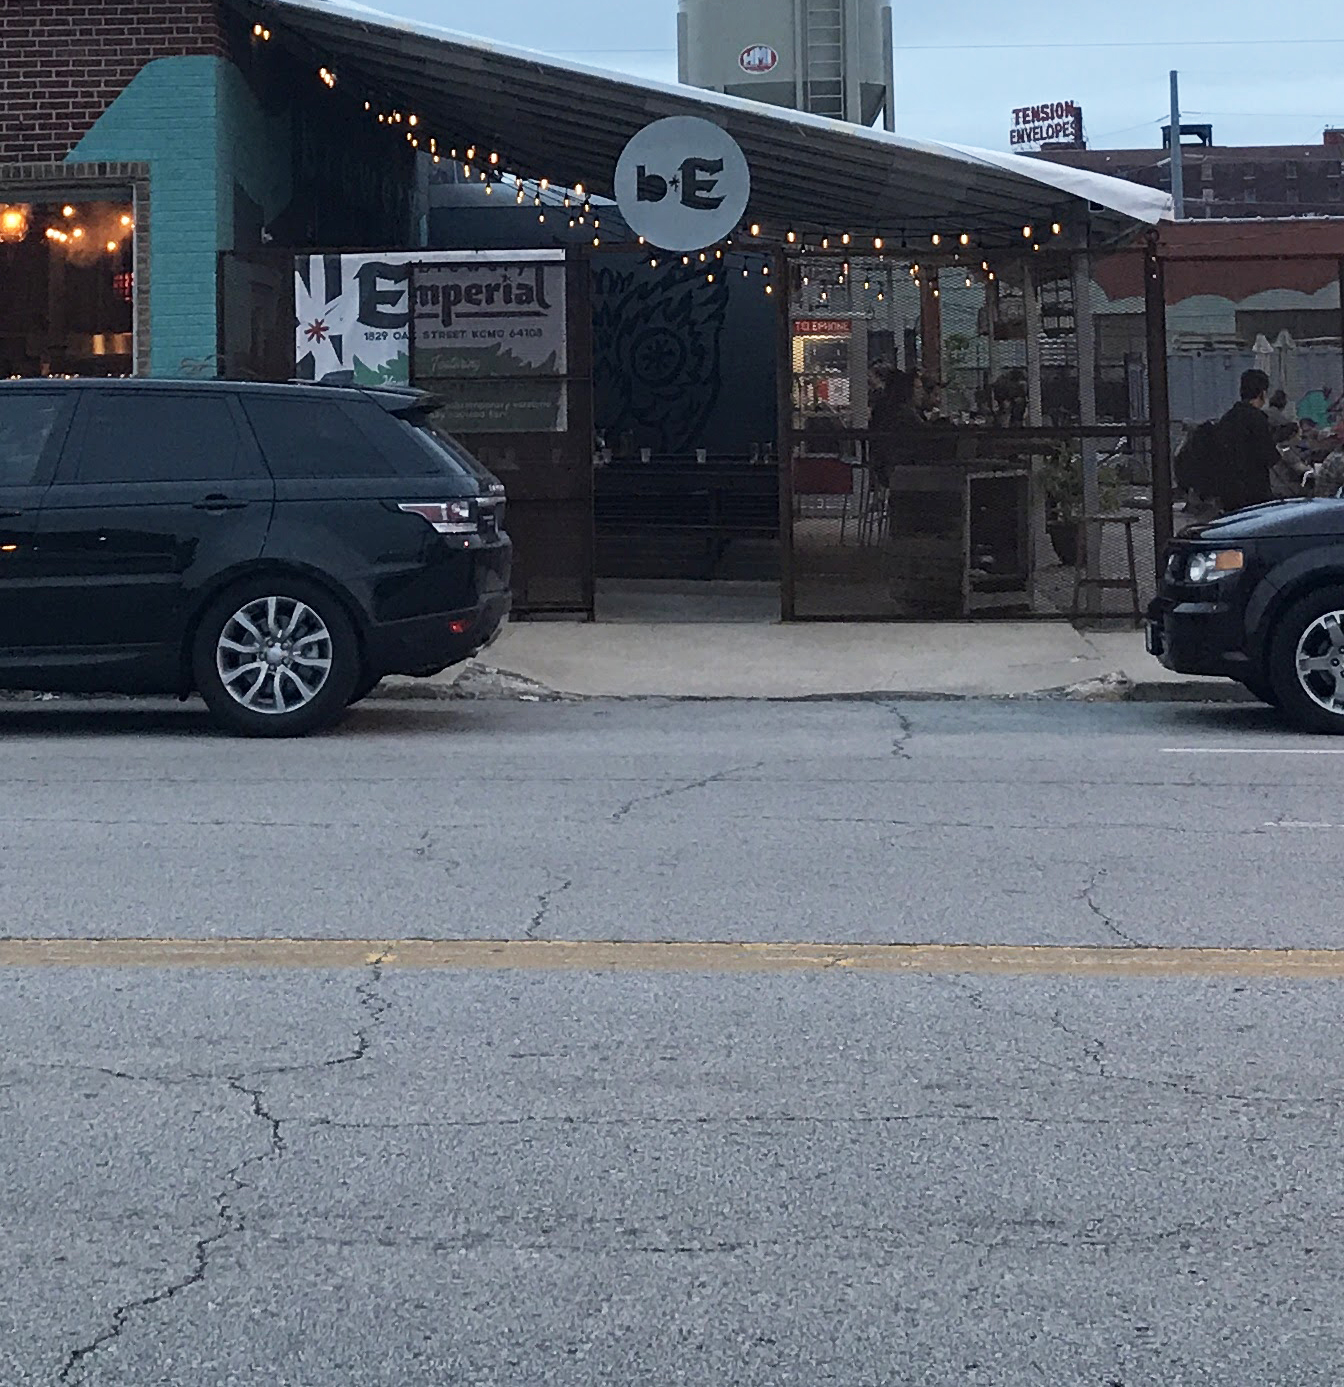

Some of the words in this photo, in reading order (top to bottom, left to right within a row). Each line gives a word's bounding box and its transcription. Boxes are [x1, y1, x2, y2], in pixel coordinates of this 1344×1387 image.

[1012, 100, 1074, 125] TENSION
[1010, 121, 1076, 145] ENVELOPES
[354, 261, 552, 329] Emperial
[364, 331, 388, 341] 1829
[393, 331, 416, 340] OA
[423, 330, 467, 340] STREET
[472, 329, 504, 338] KCMO
[509, 327, 543, 338] 64108
